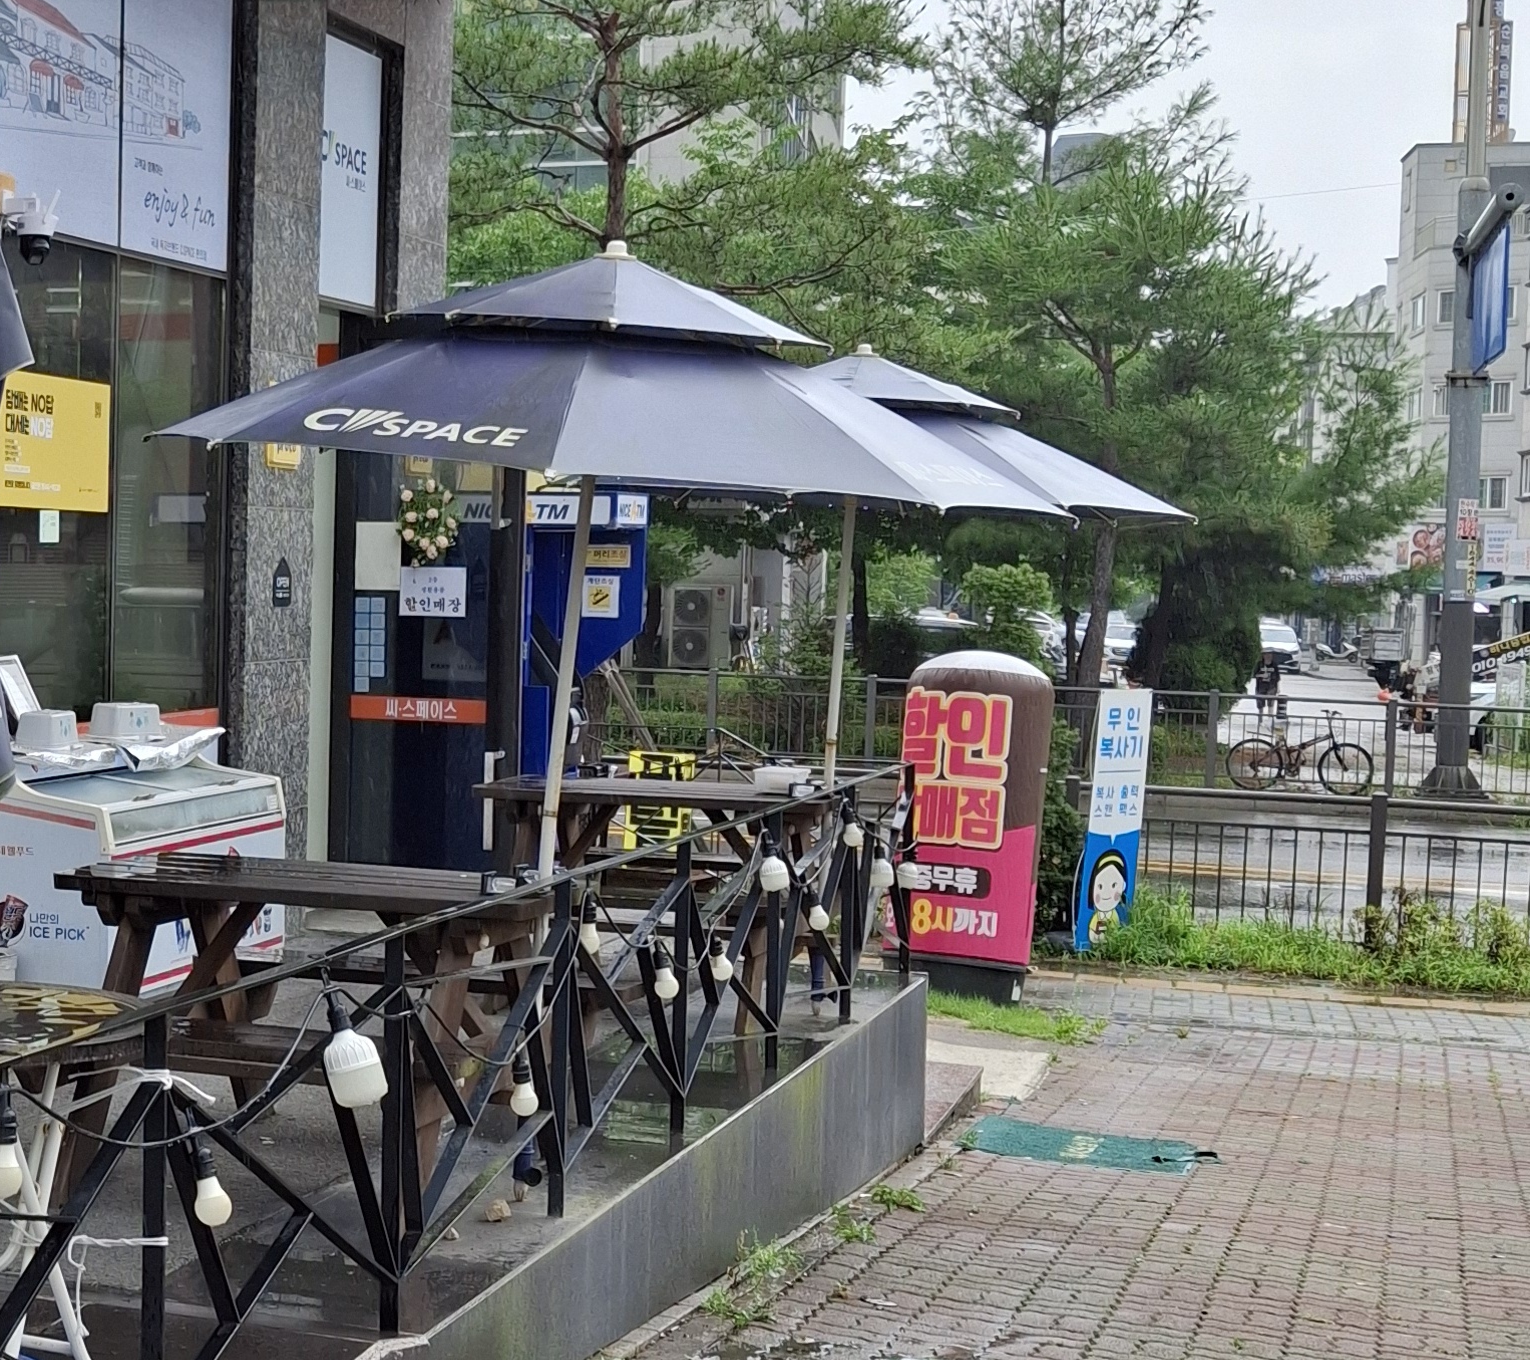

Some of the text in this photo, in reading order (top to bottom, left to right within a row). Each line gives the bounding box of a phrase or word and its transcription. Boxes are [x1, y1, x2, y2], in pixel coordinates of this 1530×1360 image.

[144, 187, 216, 231] enjoy & fun
[404, 596, 462, 613] 할인매장
[903, 689, 1009, 780] 할인
[1100, 735, 1144, 760] 복사기
[1096, 786, 1115, 800] 복사
[29, 912, 59, 926] 나만의
[911, 898, 999, 939] 8시까지
[29, 926, 85, 940] ICE PICK
